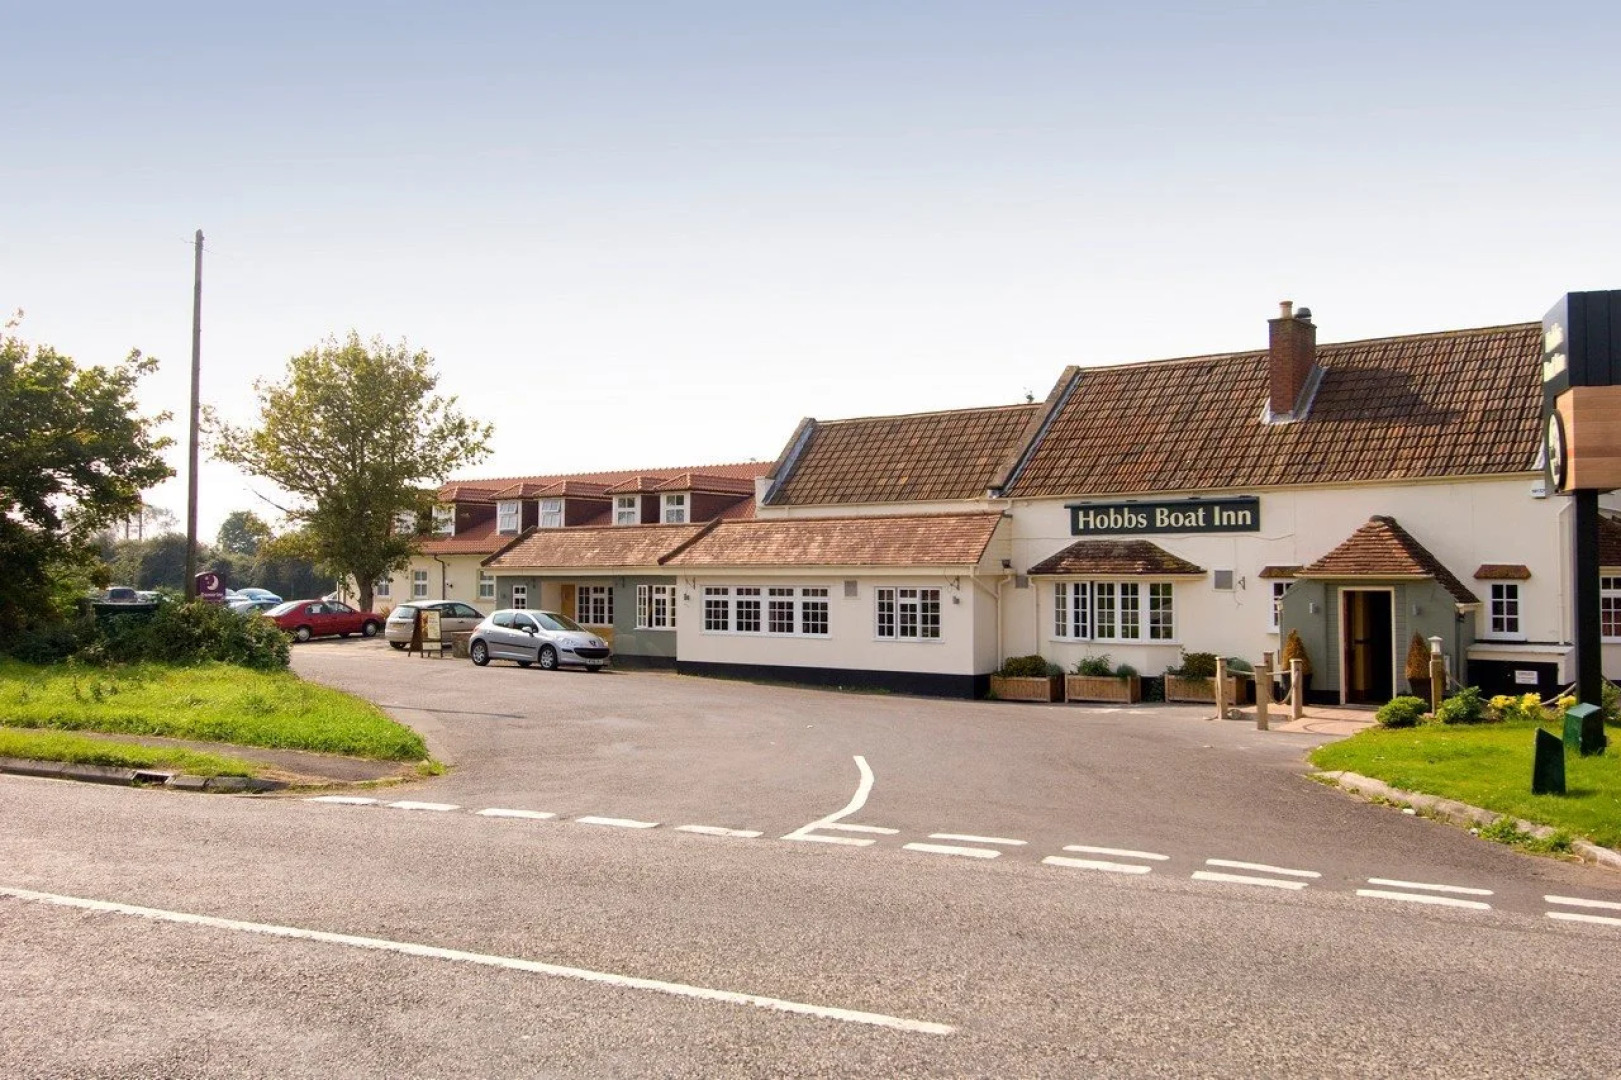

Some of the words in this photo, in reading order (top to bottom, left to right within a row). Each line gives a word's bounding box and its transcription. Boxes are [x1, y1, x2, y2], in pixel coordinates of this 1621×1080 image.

[1078, 507, 1147, 530] Hobbs
[1155, 506, 1206, 528] Boat
[1213, 505, 1252, 526] Inn
